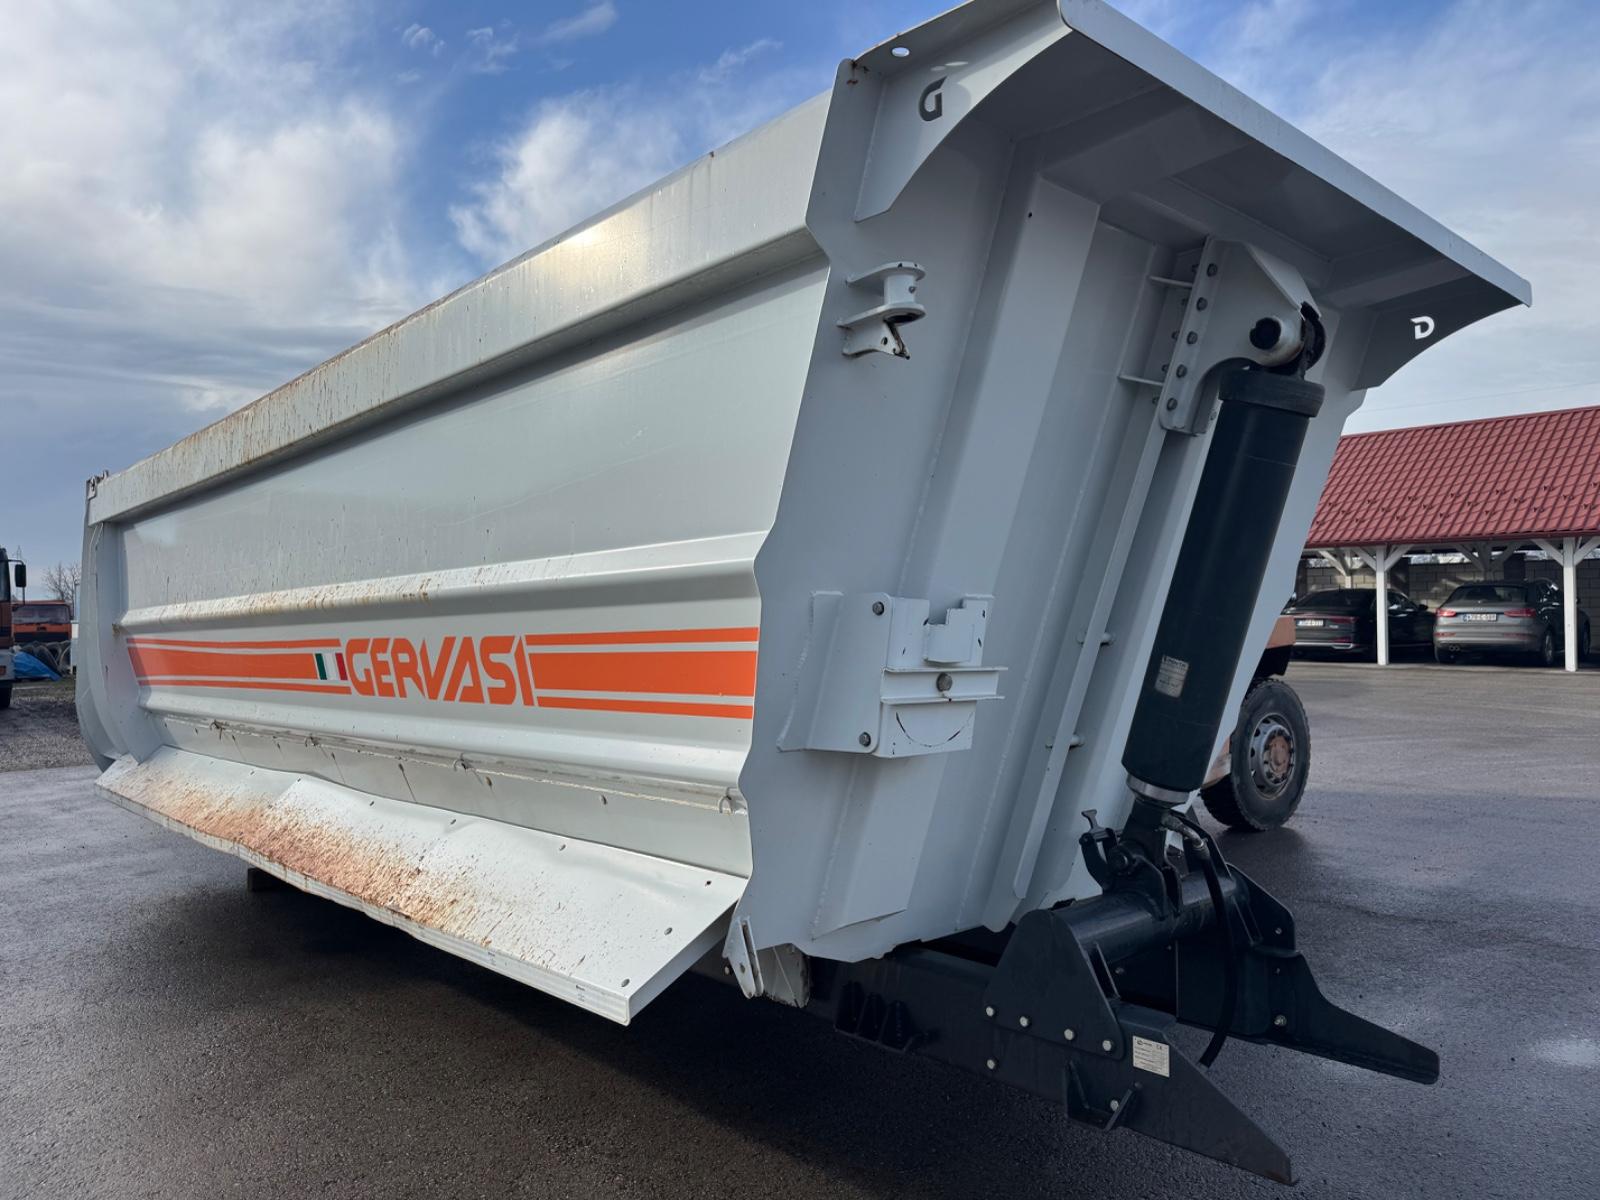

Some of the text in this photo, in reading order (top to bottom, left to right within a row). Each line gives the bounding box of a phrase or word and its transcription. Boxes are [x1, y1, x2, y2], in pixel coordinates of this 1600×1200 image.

[919, 76, 947, 121] G
[1410, 316, 1435, 339] D
[346, 635, 535, 706] GERVASI
